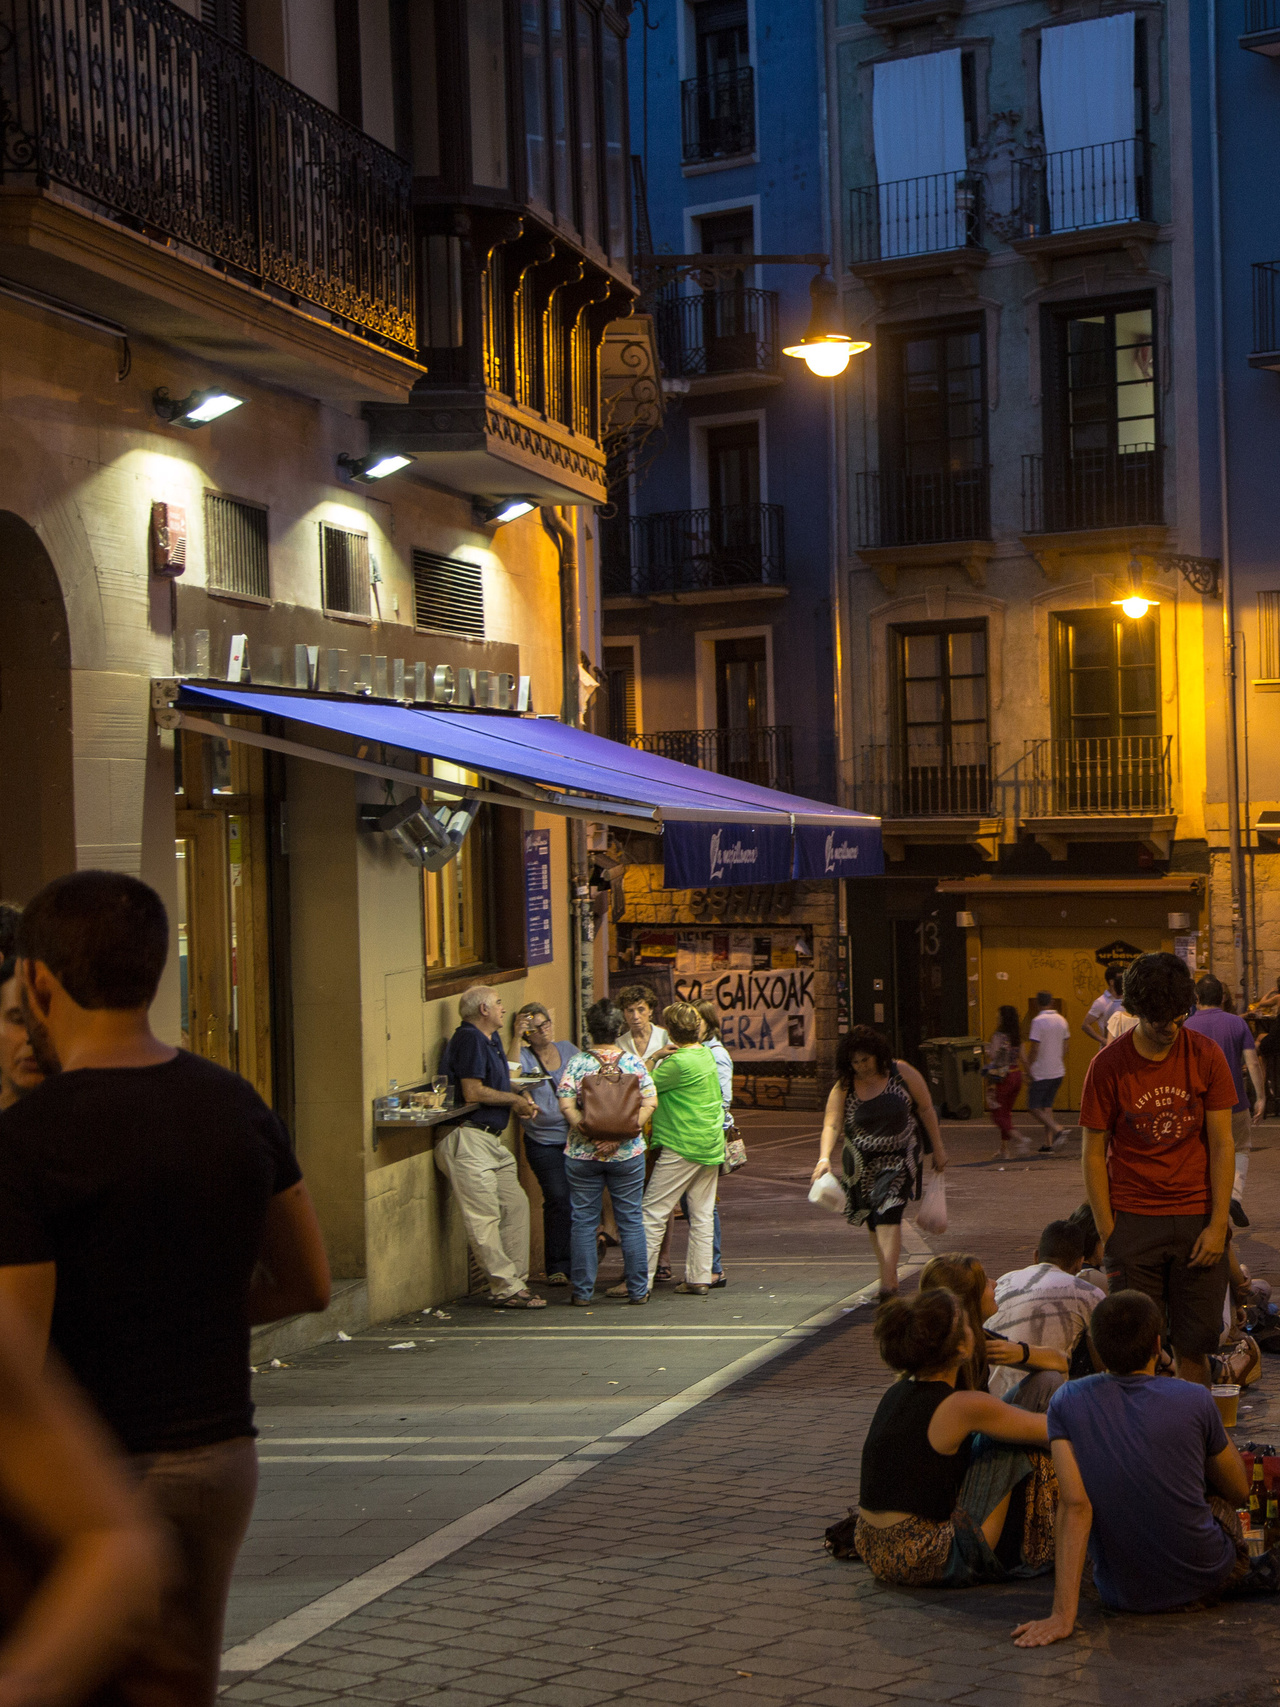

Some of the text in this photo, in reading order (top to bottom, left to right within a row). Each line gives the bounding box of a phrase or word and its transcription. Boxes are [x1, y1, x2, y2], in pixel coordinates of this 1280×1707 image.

[913, 921, 941, 956] 13
[1135, 1085, 1192, 1109] LEVI STRAUSS
